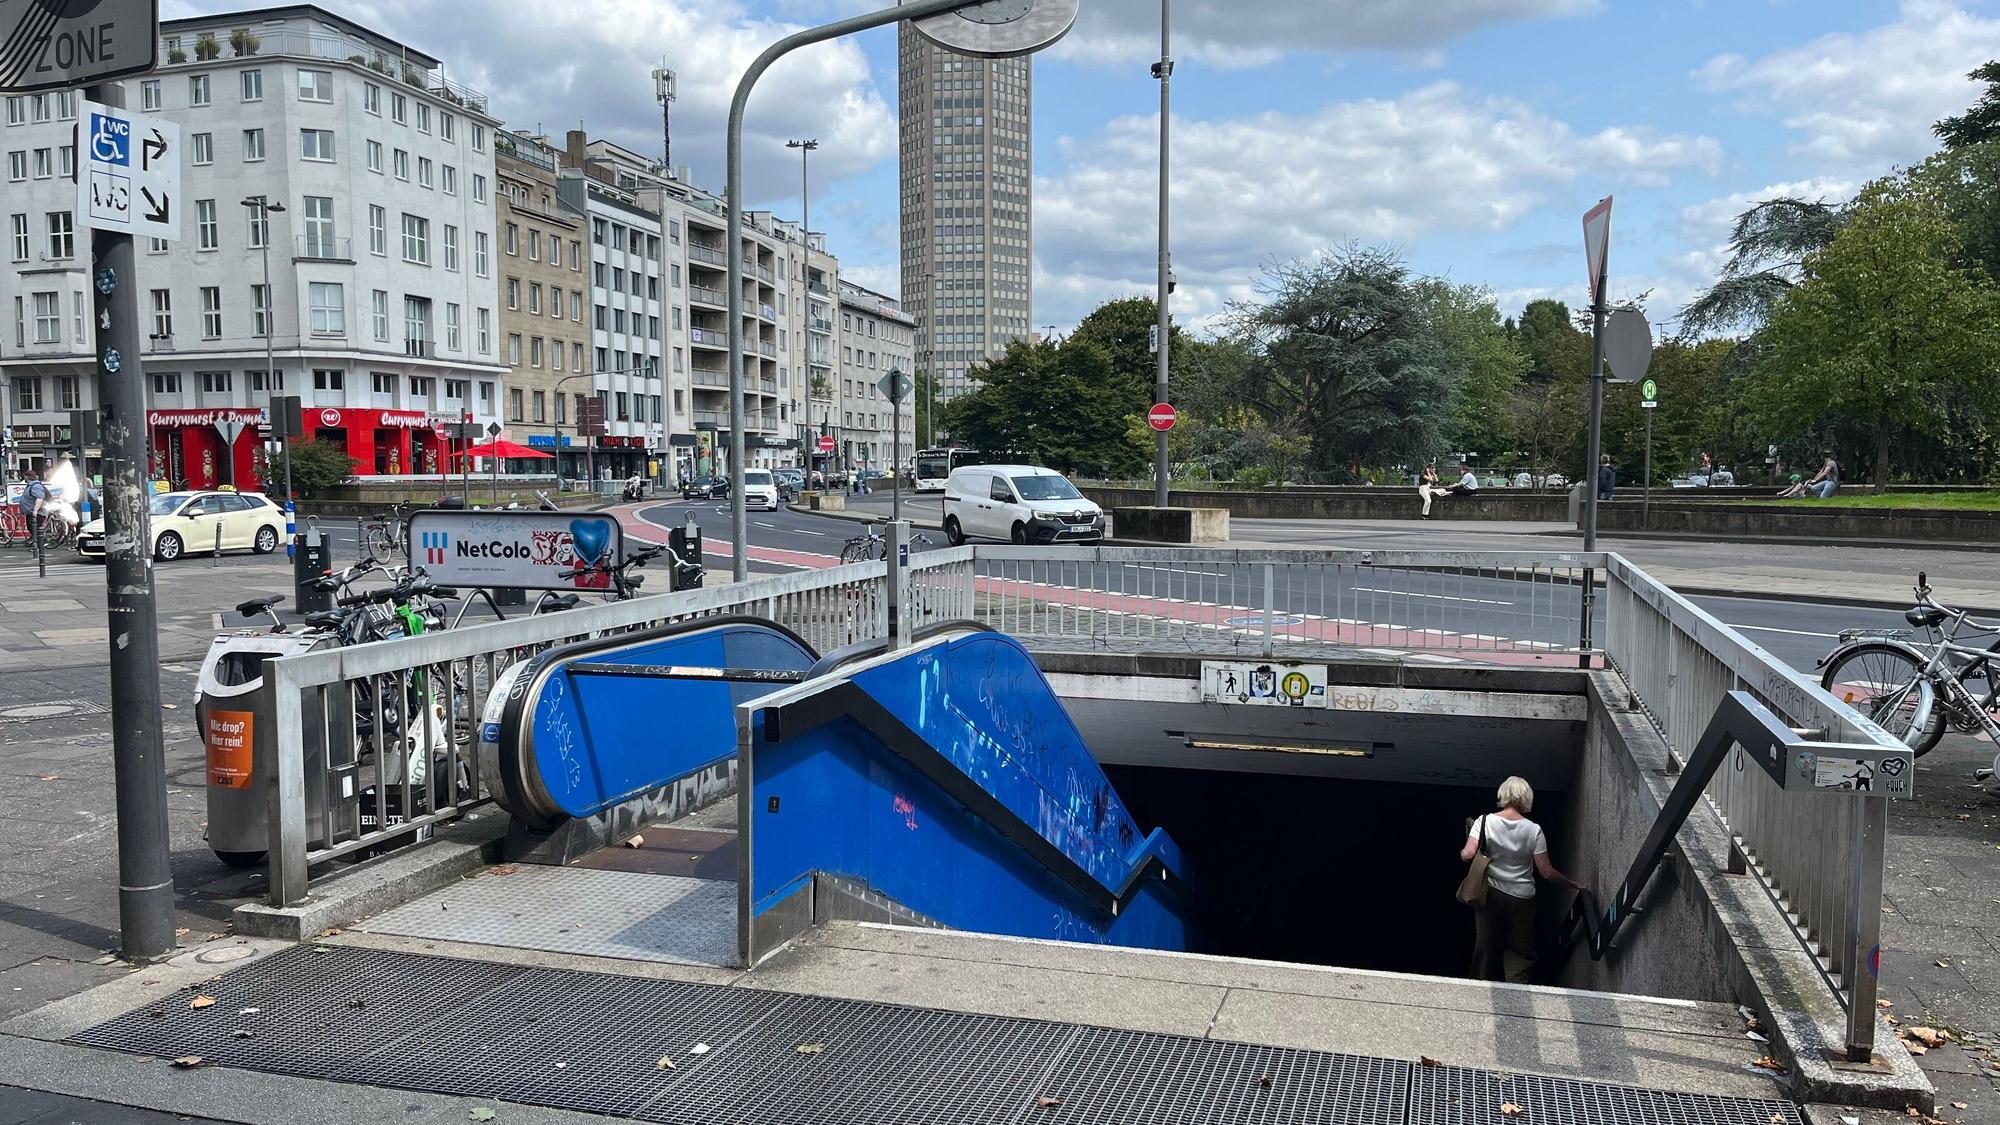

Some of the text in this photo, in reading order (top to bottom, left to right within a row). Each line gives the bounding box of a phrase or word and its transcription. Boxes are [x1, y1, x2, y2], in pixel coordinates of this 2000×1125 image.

[35, 22, 115, 73] ZONE
[107, 121, 129, 136] WC
[150, 411, 214, 428] Currywurst
[381, 412, 429, 429] Currywurst
[630, 438, 645, 448] KIOS
[456, 540, 531, 559] NetColo
[210, 719, 245, 735] Mic drop?
[211, 734, 243, 748] Hier rein!
